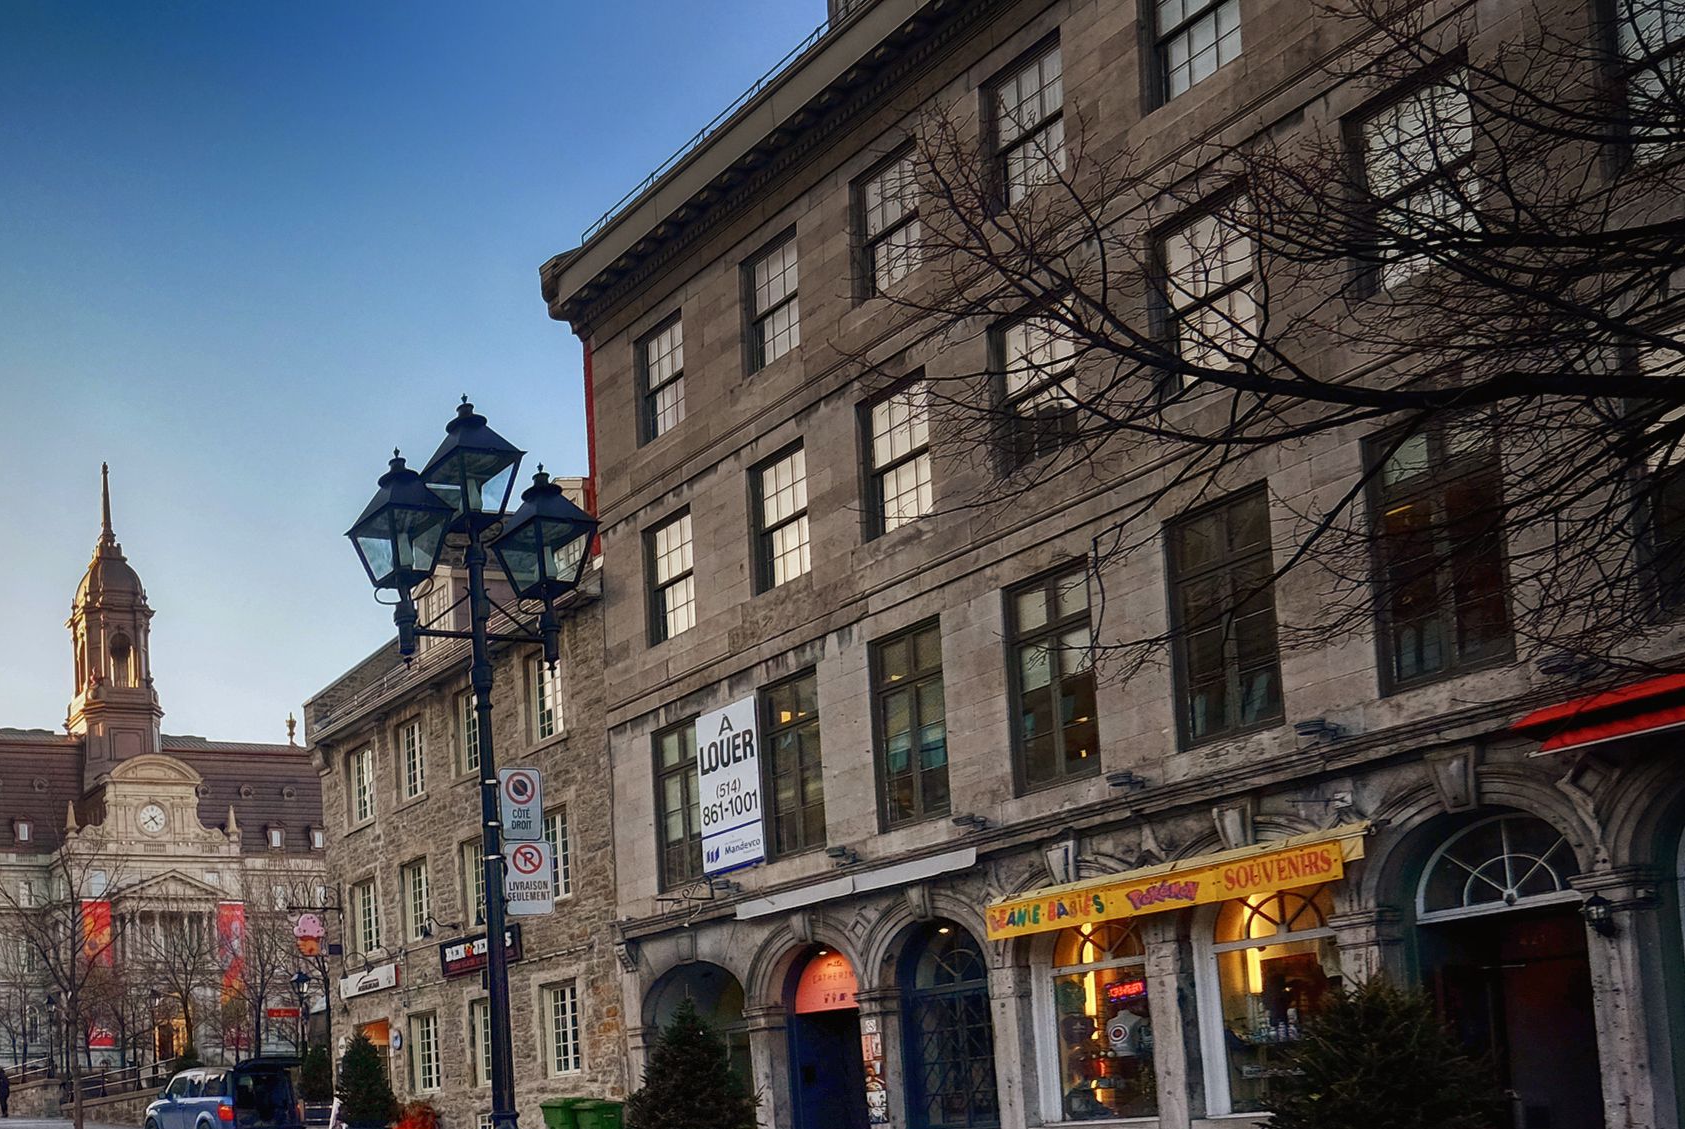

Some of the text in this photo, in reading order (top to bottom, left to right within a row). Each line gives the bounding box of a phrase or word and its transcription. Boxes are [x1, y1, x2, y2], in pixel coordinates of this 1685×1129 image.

[718, 713, 734, 737] À
[699, 728, 755, 776] LOUER
[716, 778, 742, 799] (514)
[512, 808, 531, 819] CÔTÉ
[702, 789, 758, 827] 861-1001
[511, 820, 532, 830] DROIT
[724, 838, 761, 856] Mandevco
[1224, 848, 1333, 891] SOUVENIRS
[508, 880, 549, 892] LIVRAISON
[507, 890, 551, 902] SEULEMENT
[1047, 894, 1105, 922] BABIES
[812, 970, 856, 984] CATHERIN
